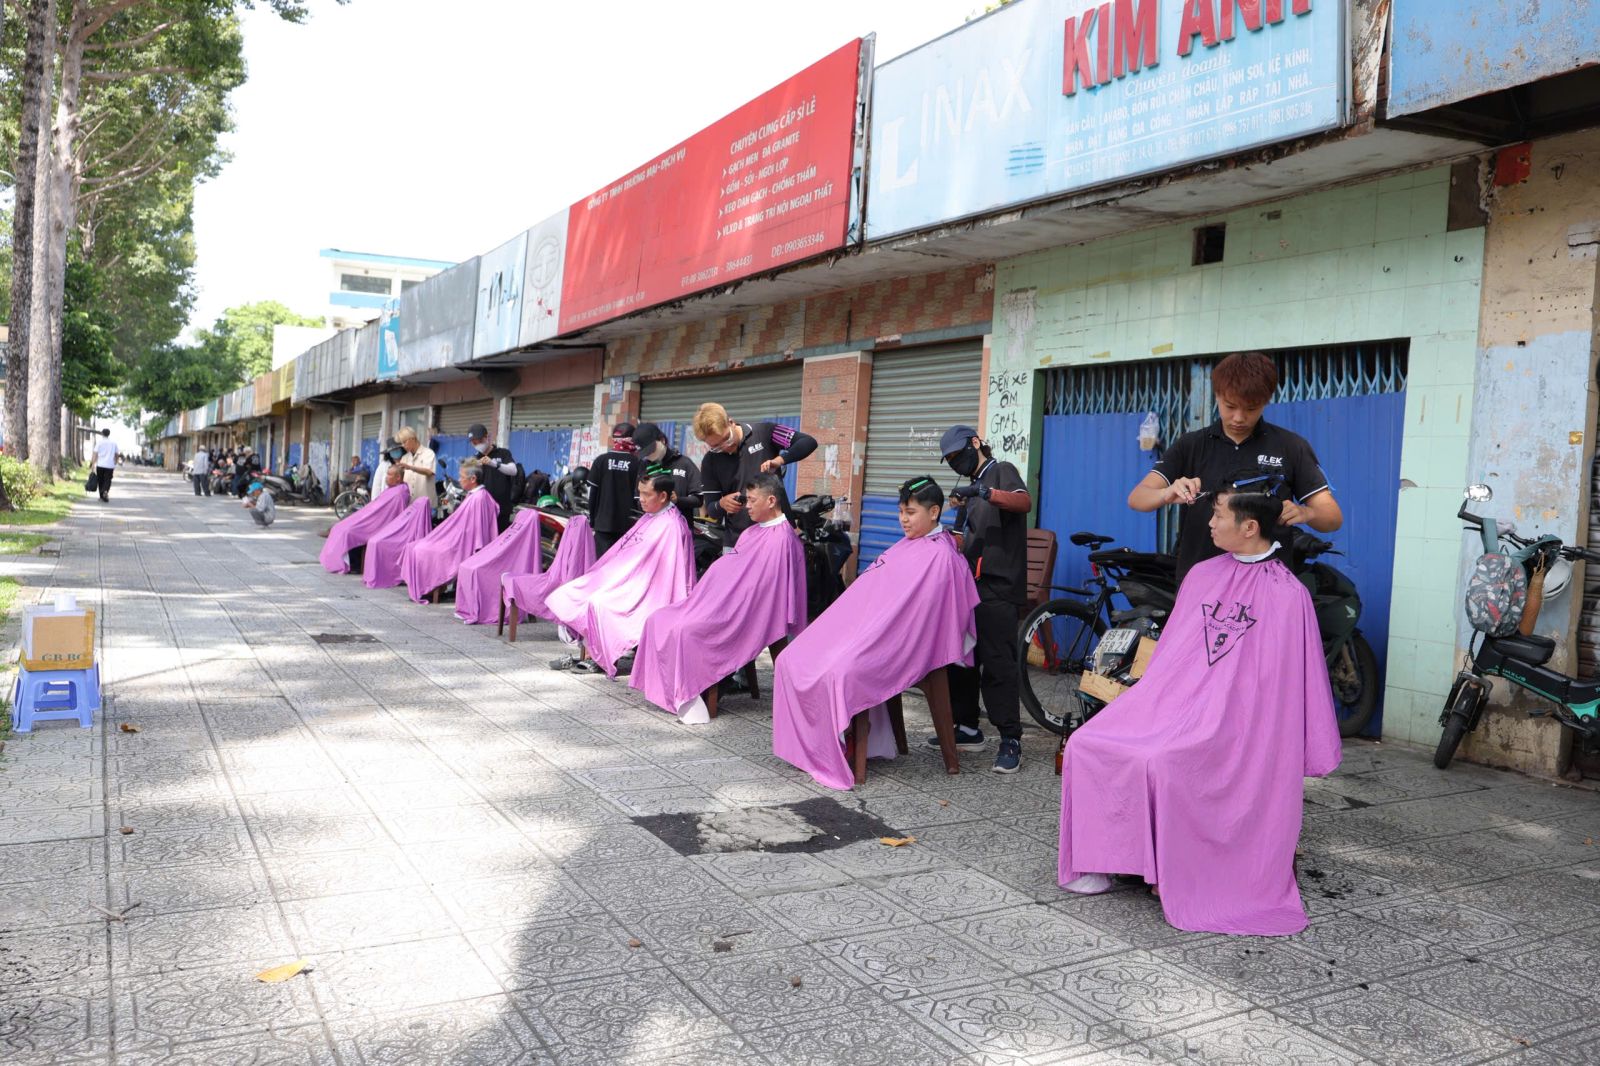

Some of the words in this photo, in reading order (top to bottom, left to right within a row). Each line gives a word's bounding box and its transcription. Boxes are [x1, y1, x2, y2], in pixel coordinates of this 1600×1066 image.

[1062, 0, 1159, 97] KIM
[758, 121, 779, 140] CUNG
[1012, 372, 1028, 386] XE
